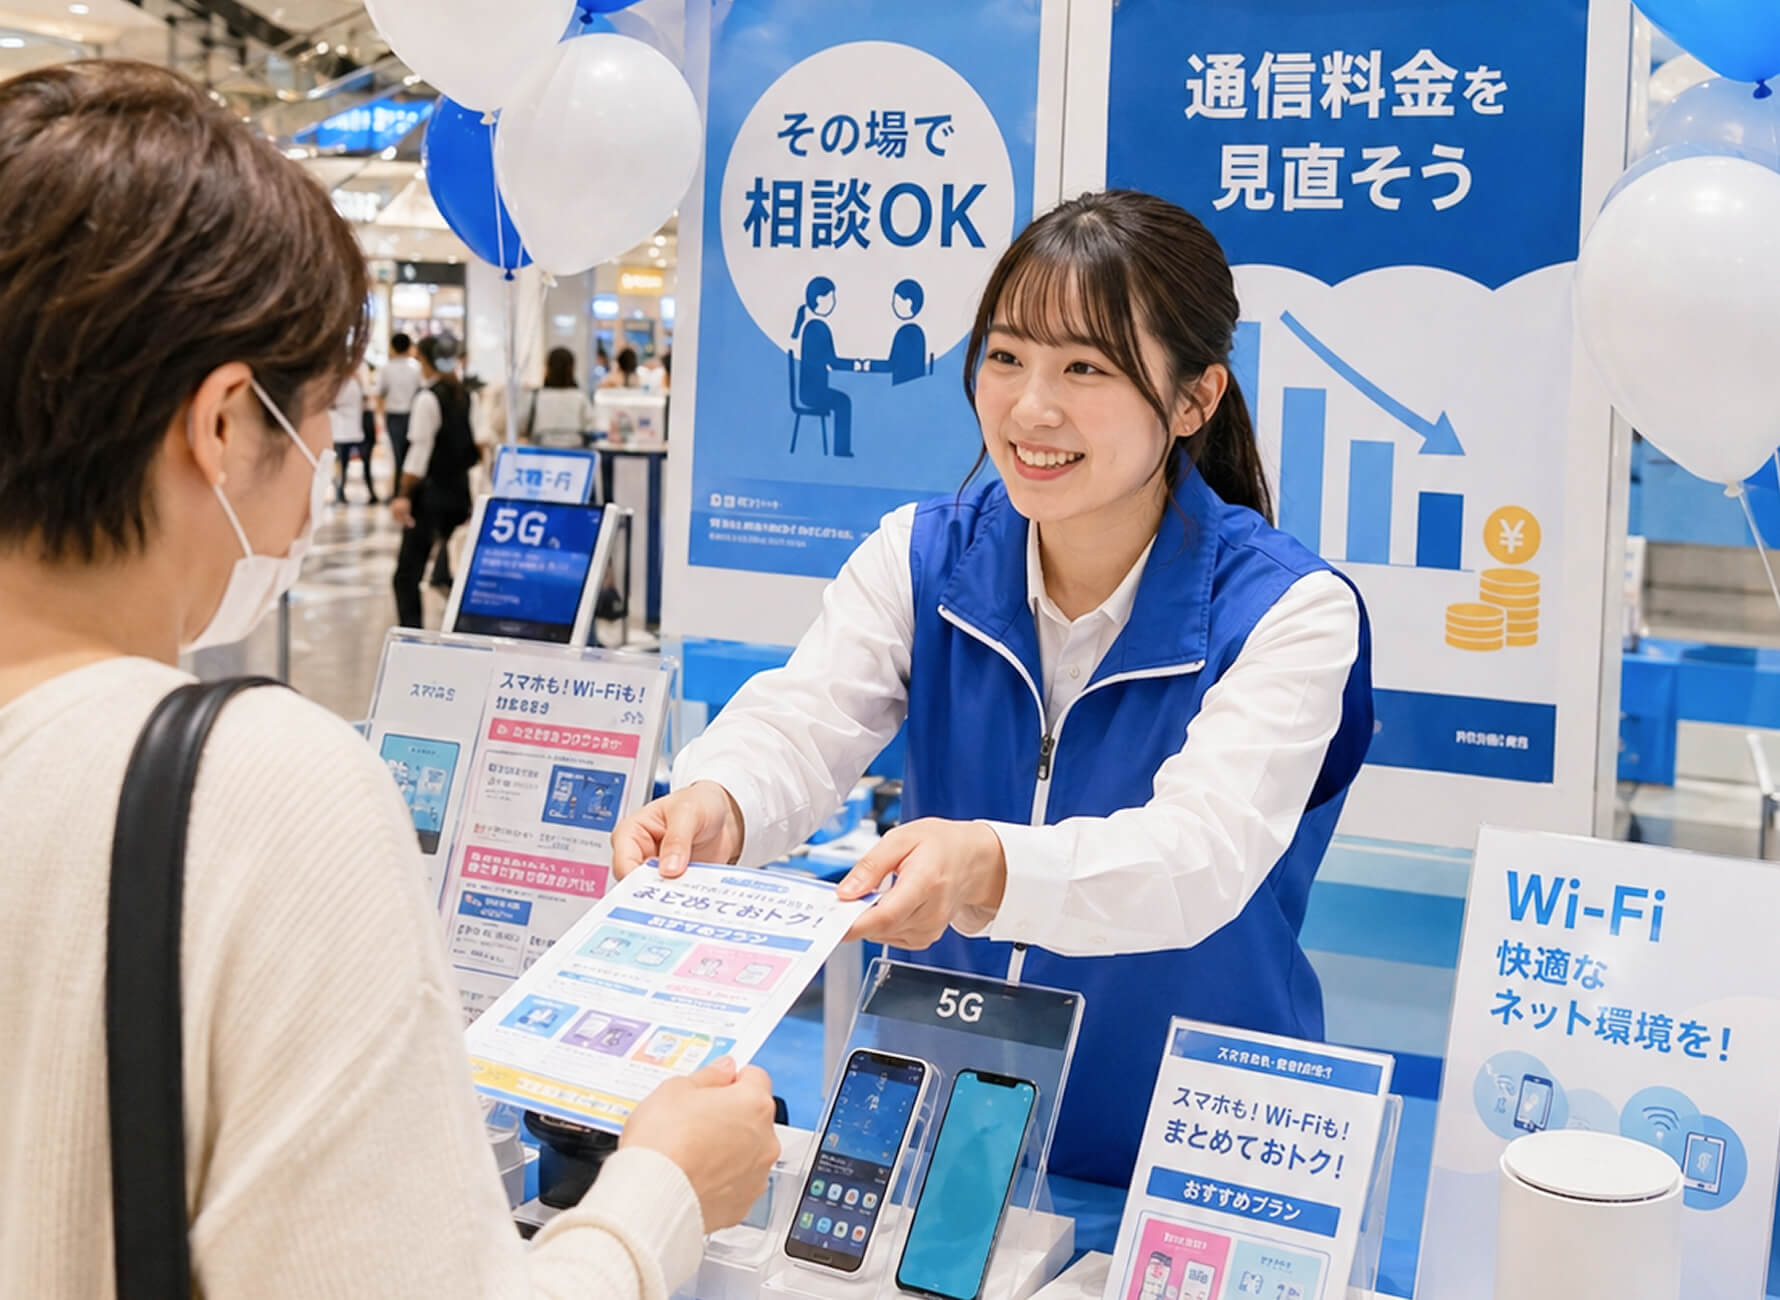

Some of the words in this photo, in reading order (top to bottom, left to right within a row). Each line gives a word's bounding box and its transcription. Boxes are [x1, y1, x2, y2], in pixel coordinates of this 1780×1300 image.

[1184, 49, 1508, 120] 通信料金を
[777, 109, 955, 158] その場で
[1212, 142, 1472, 211] 見直そう
[743, 176, 987, 249] 相談OK
[490, 508, 548, 547] 5G
[1505, 869, 1667, 943] Wi-Fi
[1496, 939, 1608, 991] 快適な
[935, 988, 985, 1023] 5G
[1490, 989, 1732, 1062] ネット環境を！
[1163, 1118, 1345, 1180] まとめておトク！
[1183, 1179, 1302, 1222] おすすめプラン
